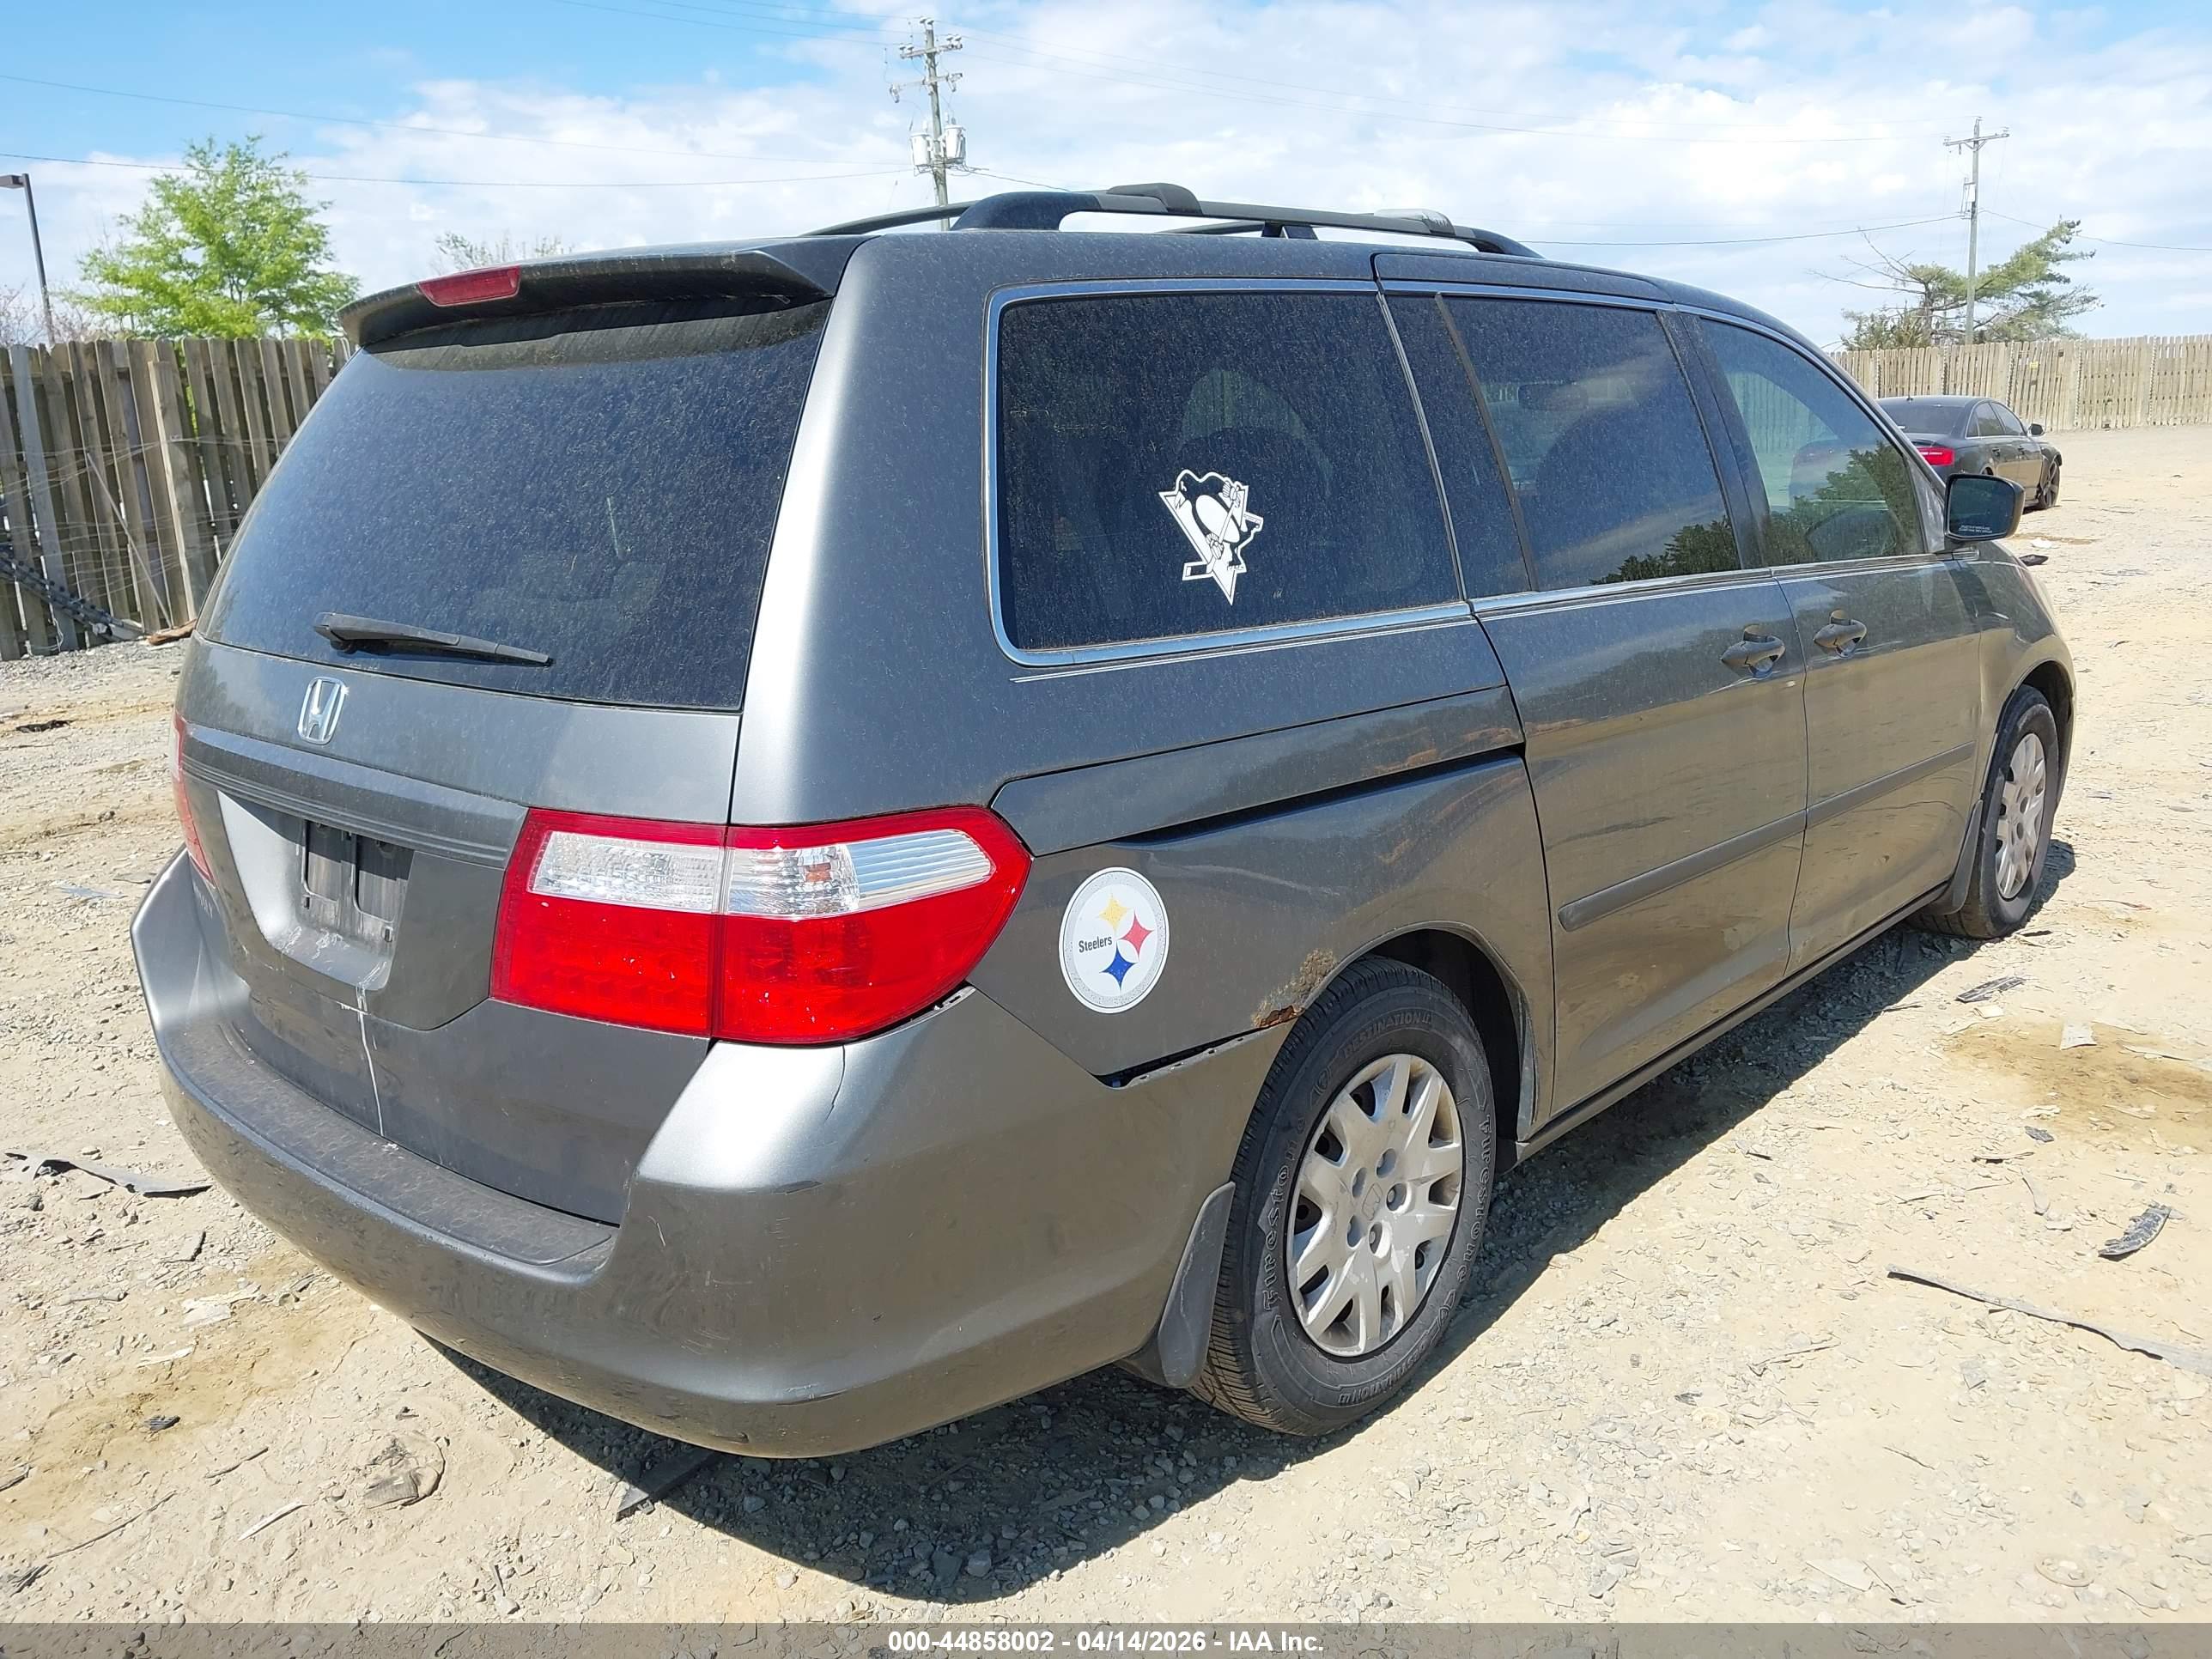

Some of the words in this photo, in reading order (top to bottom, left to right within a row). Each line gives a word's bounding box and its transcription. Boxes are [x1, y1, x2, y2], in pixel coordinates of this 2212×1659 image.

[1078, 936, 1113, 953] Steelers
[1261, 1117, 1306, 1311] Firestone
[1456, 1115, 1492, 1282] Firestone
